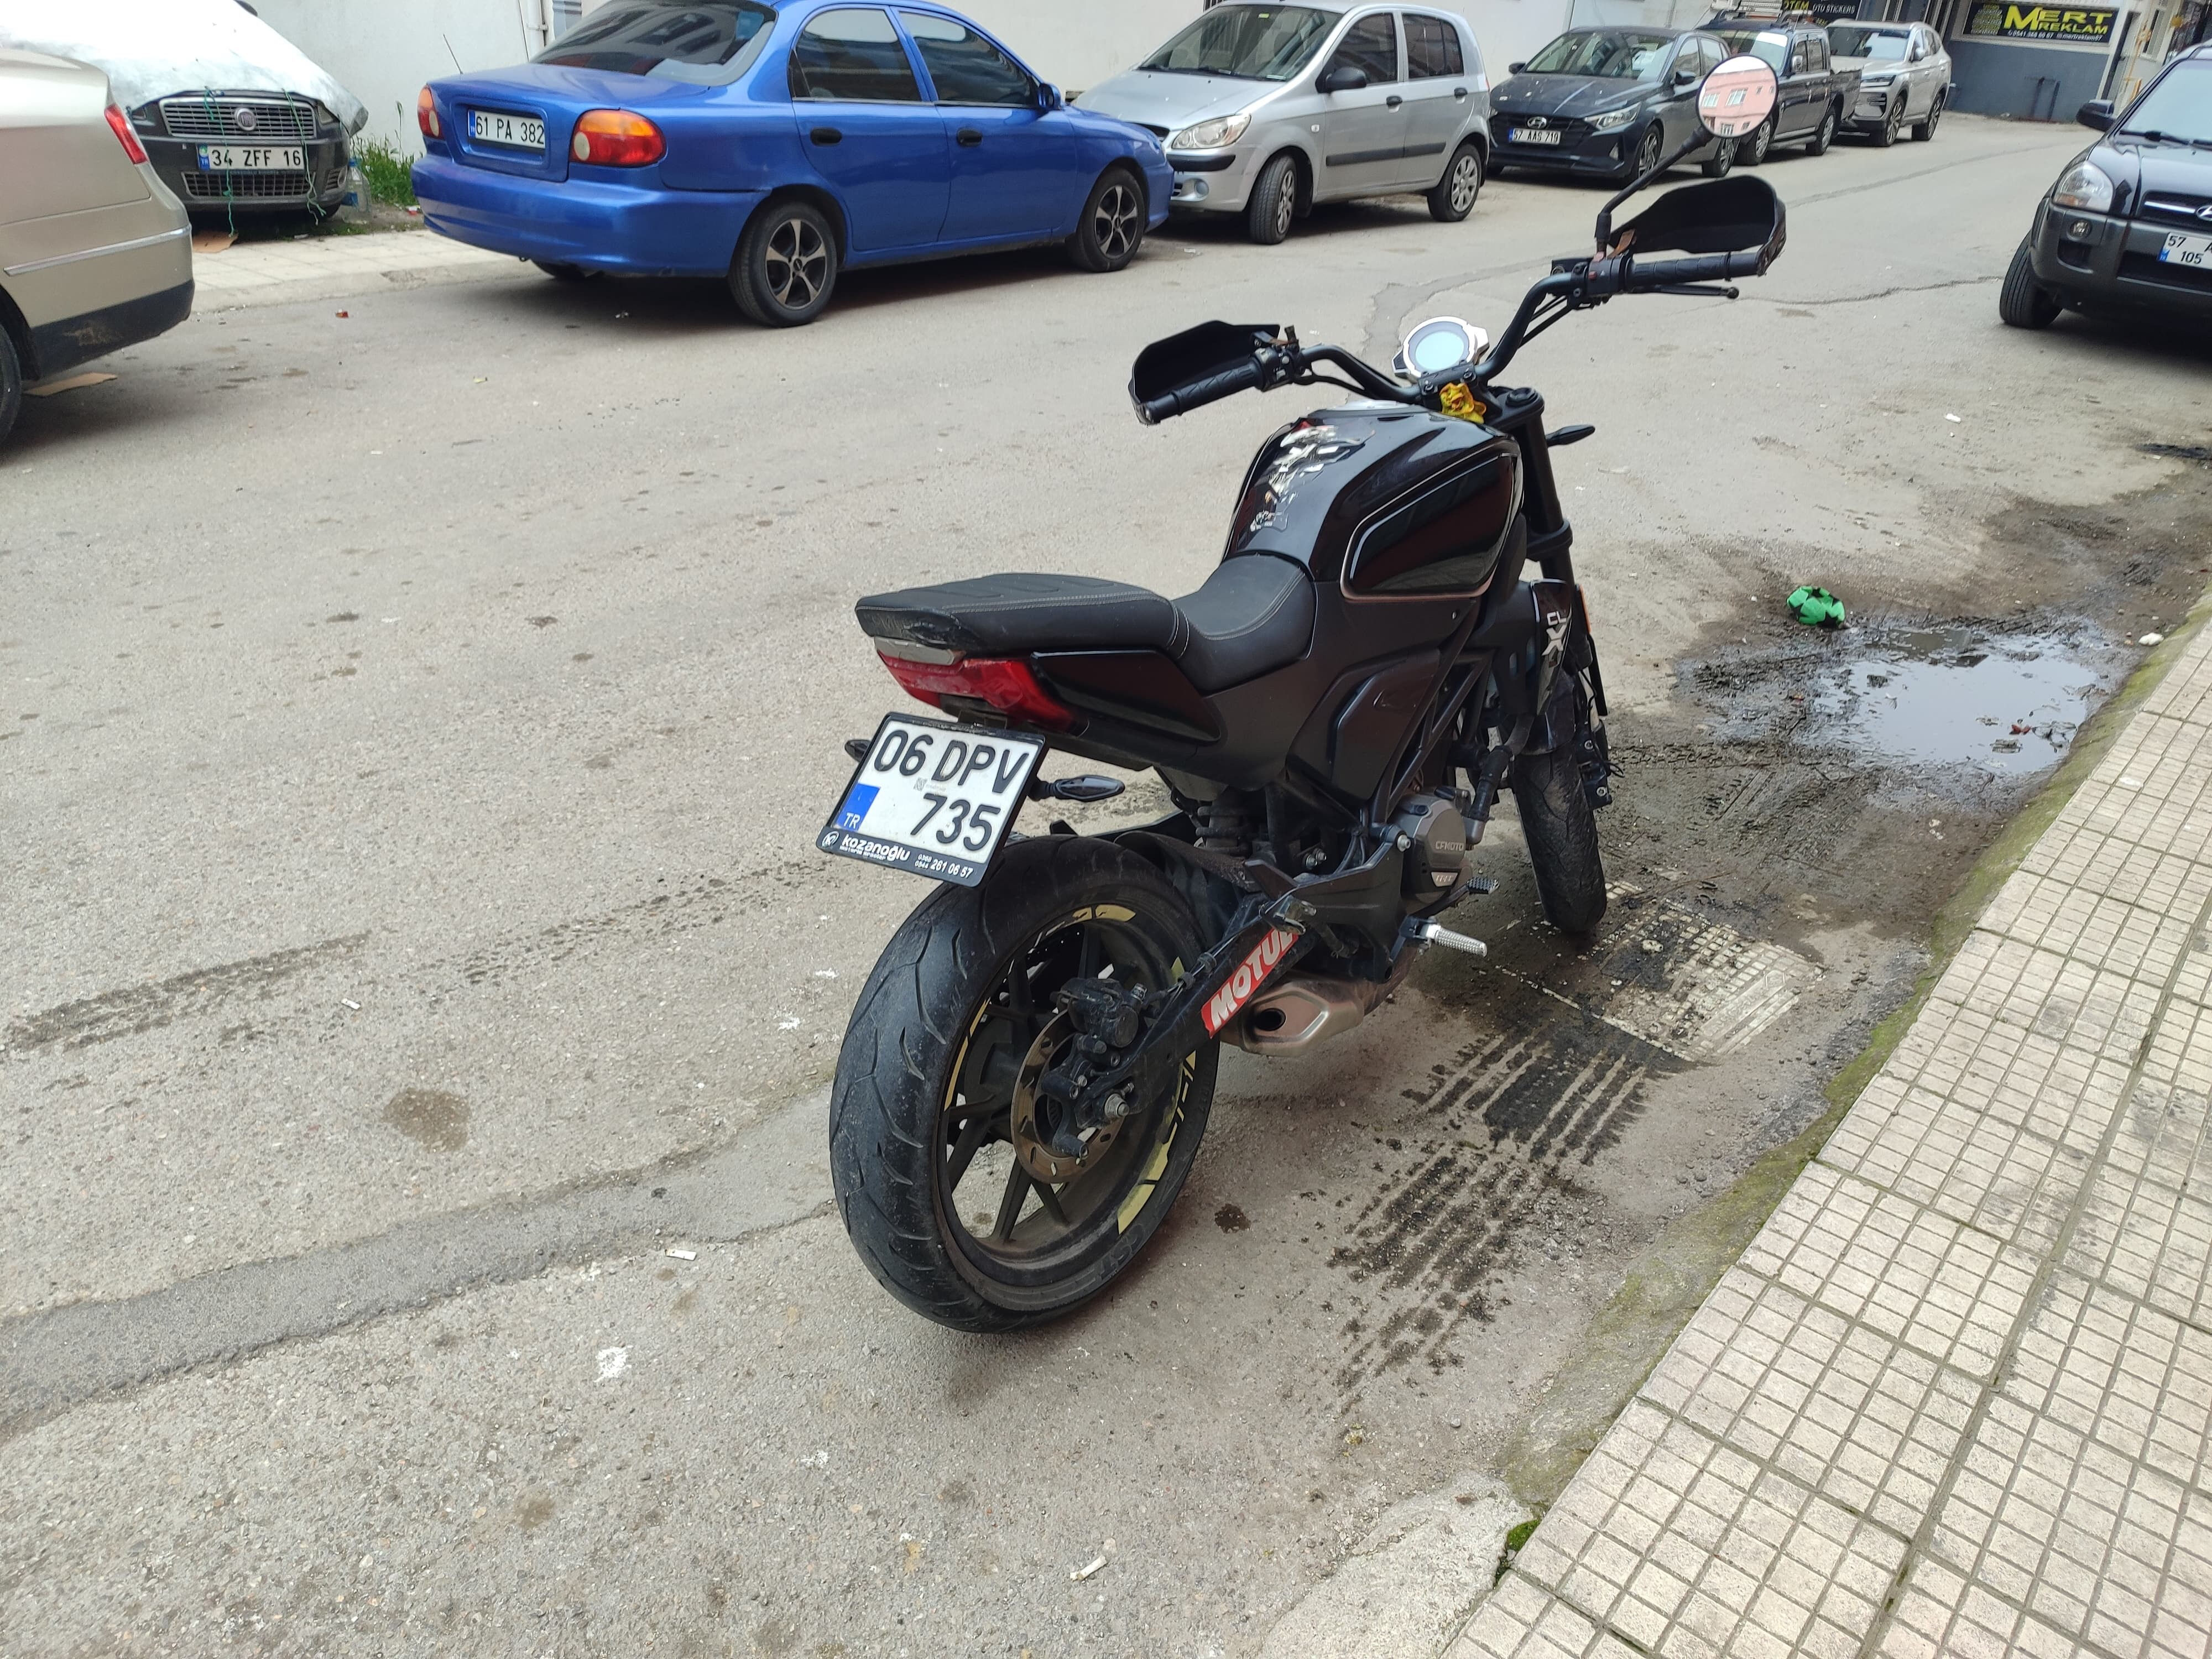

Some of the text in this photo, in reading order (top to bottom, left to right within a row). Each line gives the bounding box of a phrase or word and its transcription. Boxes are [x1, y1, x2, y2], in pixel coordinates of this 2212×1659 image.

[2004, 5, 2112, 30] MERT
[2038, 22, 2109, 34] REKLAM
[476, 116, 544, 144] 61 PA 382
[211, 149, 301, 166] 34 ZFF 16
[2168, 236, 2187, 248] 57
[2180, 251, 2204, 264] 105
[874, 730, 1029, 794] 06 DPV
[844, 812, 860, 830] TR
[910, 792, 1001, 851] 735
[842, 834, 911, 862] kozanoğlu
[1435, 841, 1464, 852] CFMOTO
[930, 858, 973, 879] 261 06 57
[1211, 930, 1293, 1031] MOTUL
